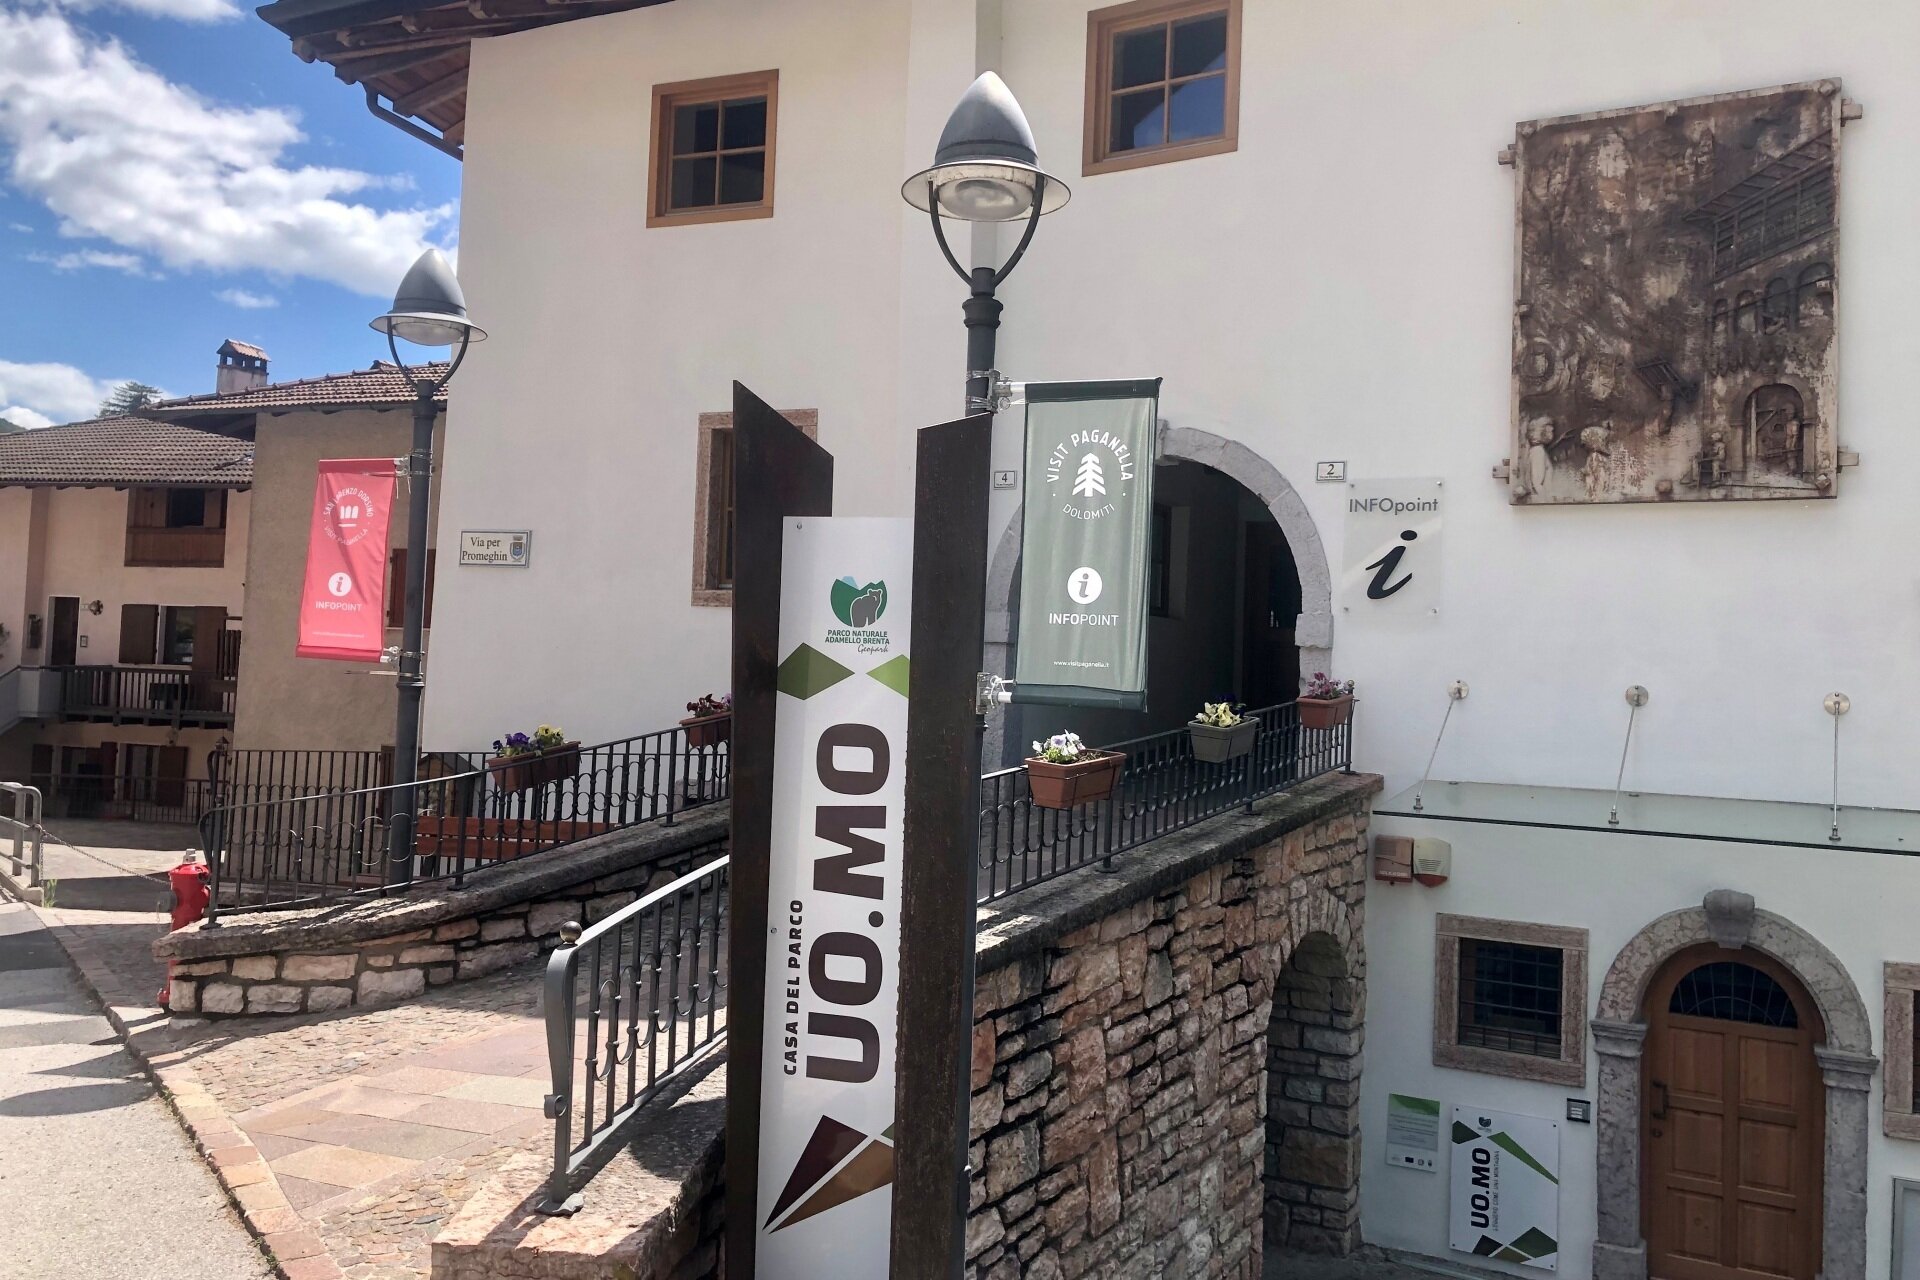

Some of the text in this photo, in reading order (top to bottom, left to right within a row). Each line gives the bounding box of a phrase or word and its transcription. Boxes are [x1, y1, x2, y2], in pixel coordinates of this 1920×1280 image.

[1046, 429, 1134, 483] VISIT PAGANELLA
[1326, 463, 1335, 476] 2
[1001, 472, 1008, 483] 4
[323, 501, 336, 516] SAN
[1062, 503, 1115, 520] DOLOMITI
[1349, 497, 1439, 516] INFOpoint
[470, 536, 502, 550] Via per
[461, 550, 508, 564] Promeghin
[315, 600, 363, 612] INFOPOINT
[1048, 612, 1120, 627] INFOPOINT
[825, 636, 890, 645] ADAMELLO BRENTA
[827, 629, 888, 638] PARCO NATURALE
[857, 644, 889, 655] Geopark
[805, 722, 891, 1084] UO.MO
[783, 900, 803, 1075] CASA DEL PARCO
[1470, 1147, 1491, 1229] UO.MO
